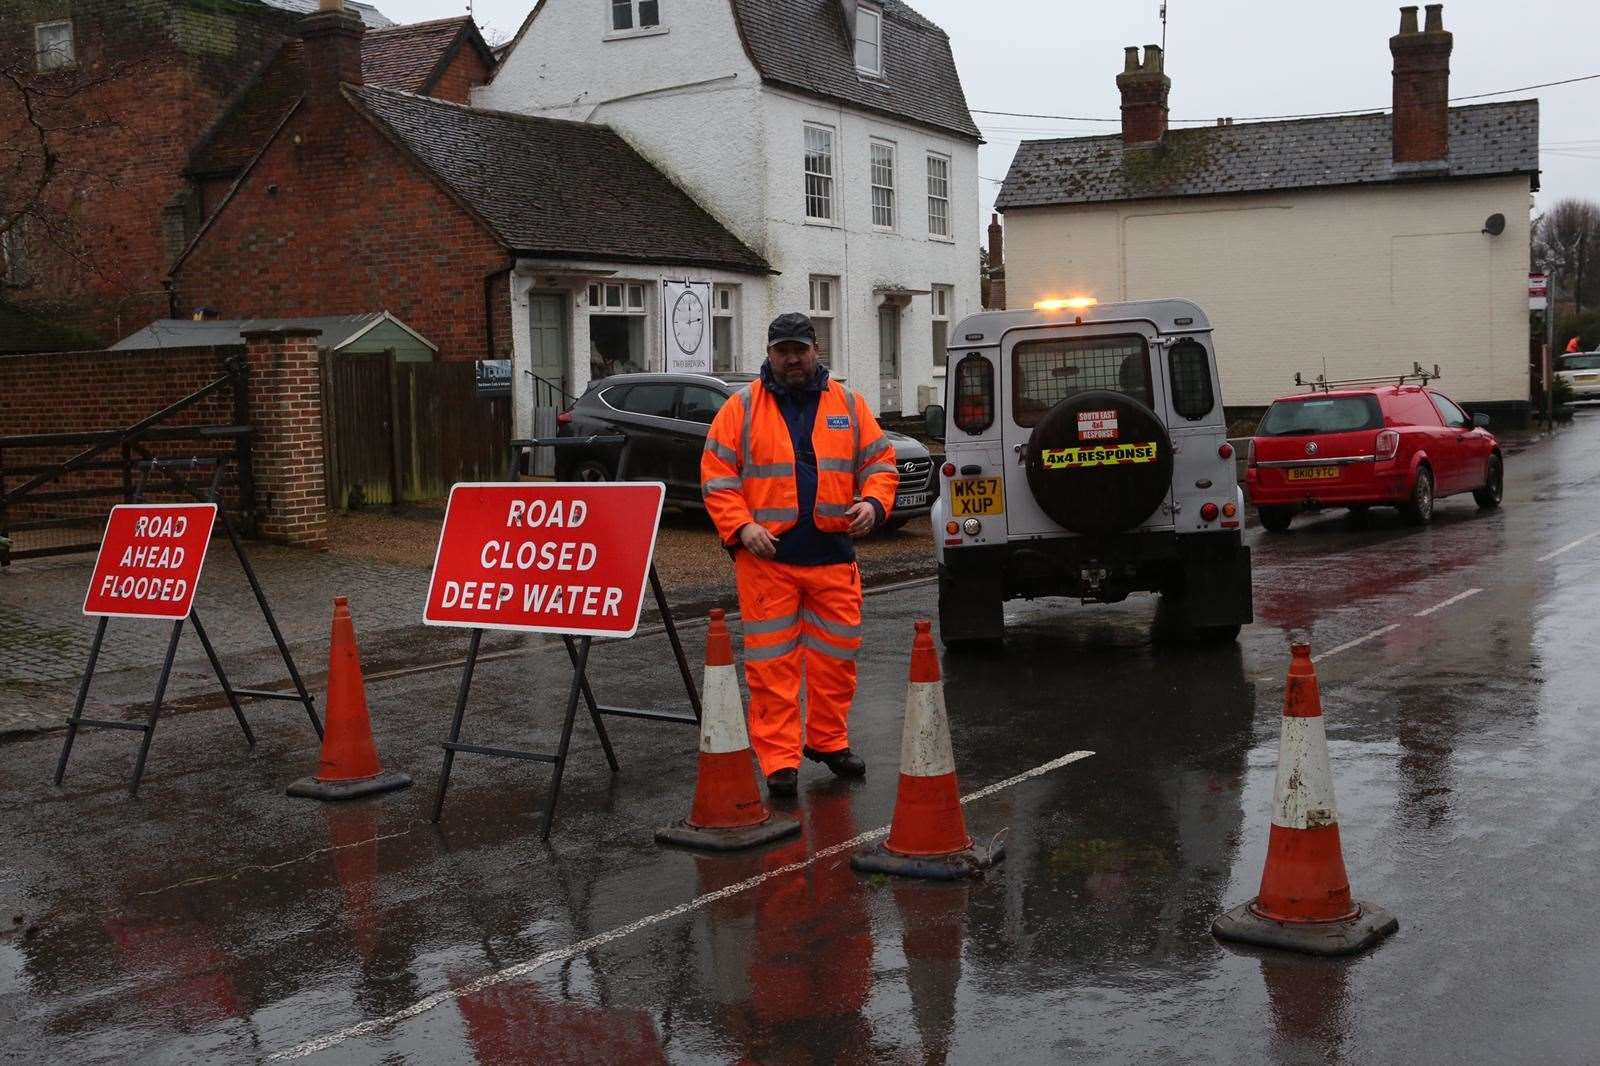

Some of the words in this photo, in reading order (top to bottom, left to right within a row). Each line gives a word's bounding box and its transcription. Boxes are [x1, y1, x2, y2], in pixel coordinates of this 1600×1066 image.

[1079, 411, 1100, 421] SOUTH
[1100, 410, 1115, 420] EAST
[1083, 430, 1114, 439] RESPONSE
[1047, 452, 1074, 464] 4x4
[1077, 447, 1153, 462] RESPONSE
[954, 479, 998, 497] WK57
[507, 499, 587, 528] ROAD
[961, 497, 993, 514] XUP
[135, 515, 188, 538] ROAD
[119, 545, 185, 569] AHEAD
[480, 540, 597, 571] CLOSED
[100, 575, 187, 602] FLOODED
[441, 581, 514, 611] DEEP
[523, 584, 623, 616] WATER
